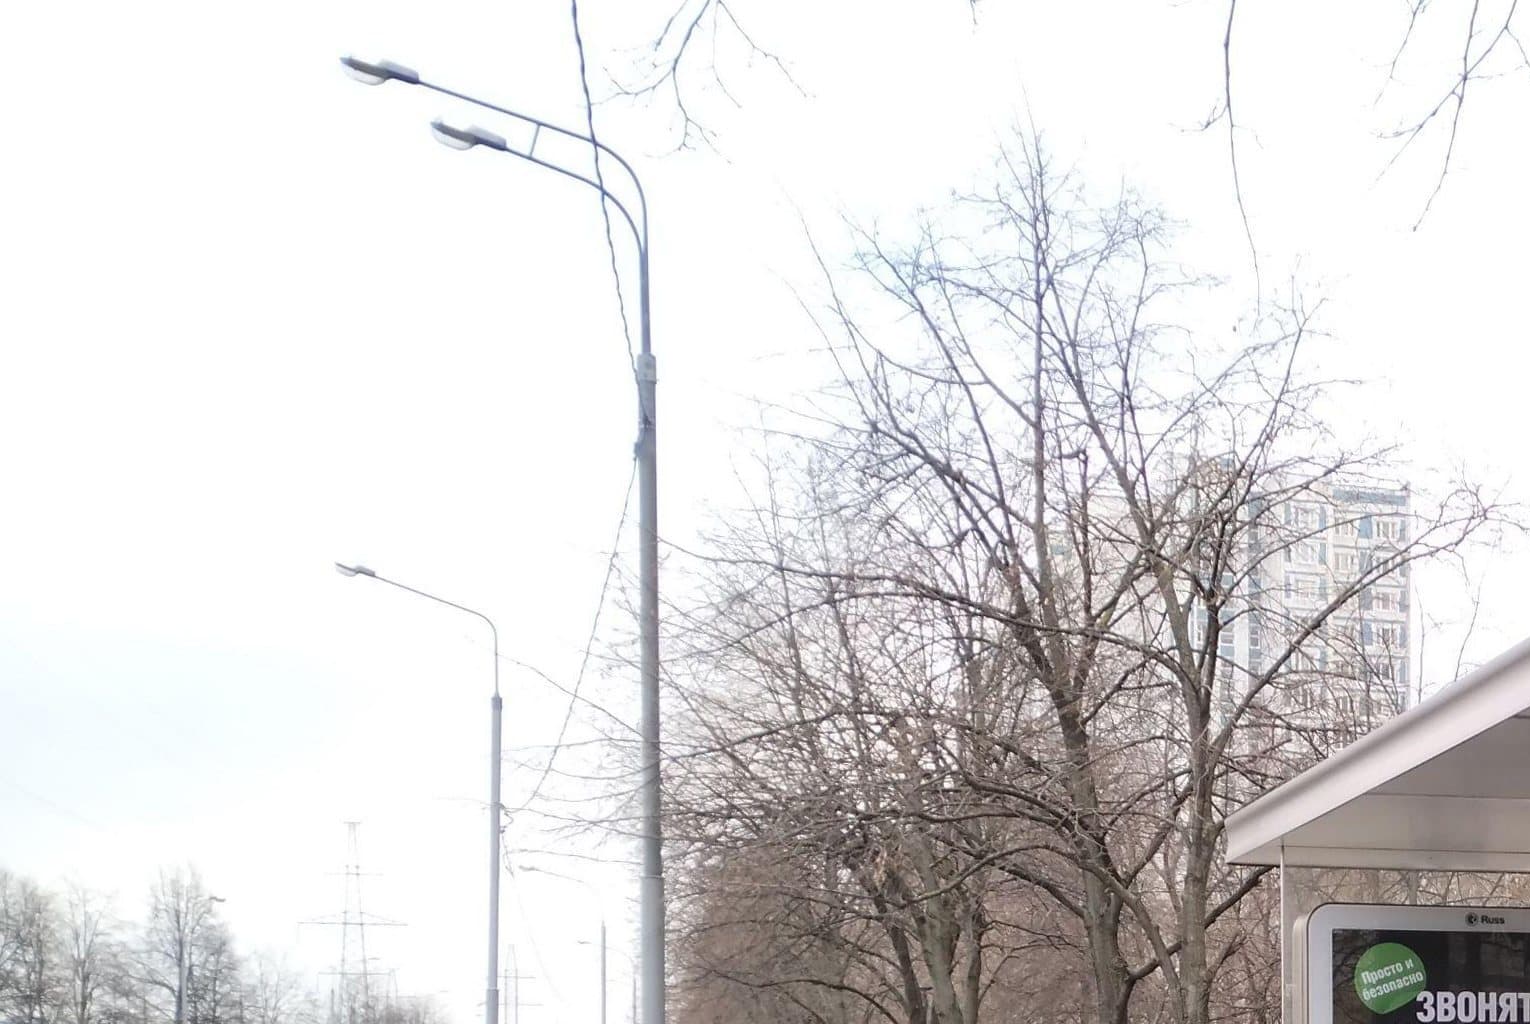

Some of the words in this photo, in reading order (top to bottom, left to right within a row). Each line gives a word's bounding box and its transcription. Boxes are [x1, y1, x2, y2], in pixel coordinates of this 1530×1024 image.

[1481, 915, 1505, 924] Russ
[1361, 962, 1403, 985] Просто
[1406, 959, 1414, 969] и
[1362, 971, 1424, 1001] безопасно
